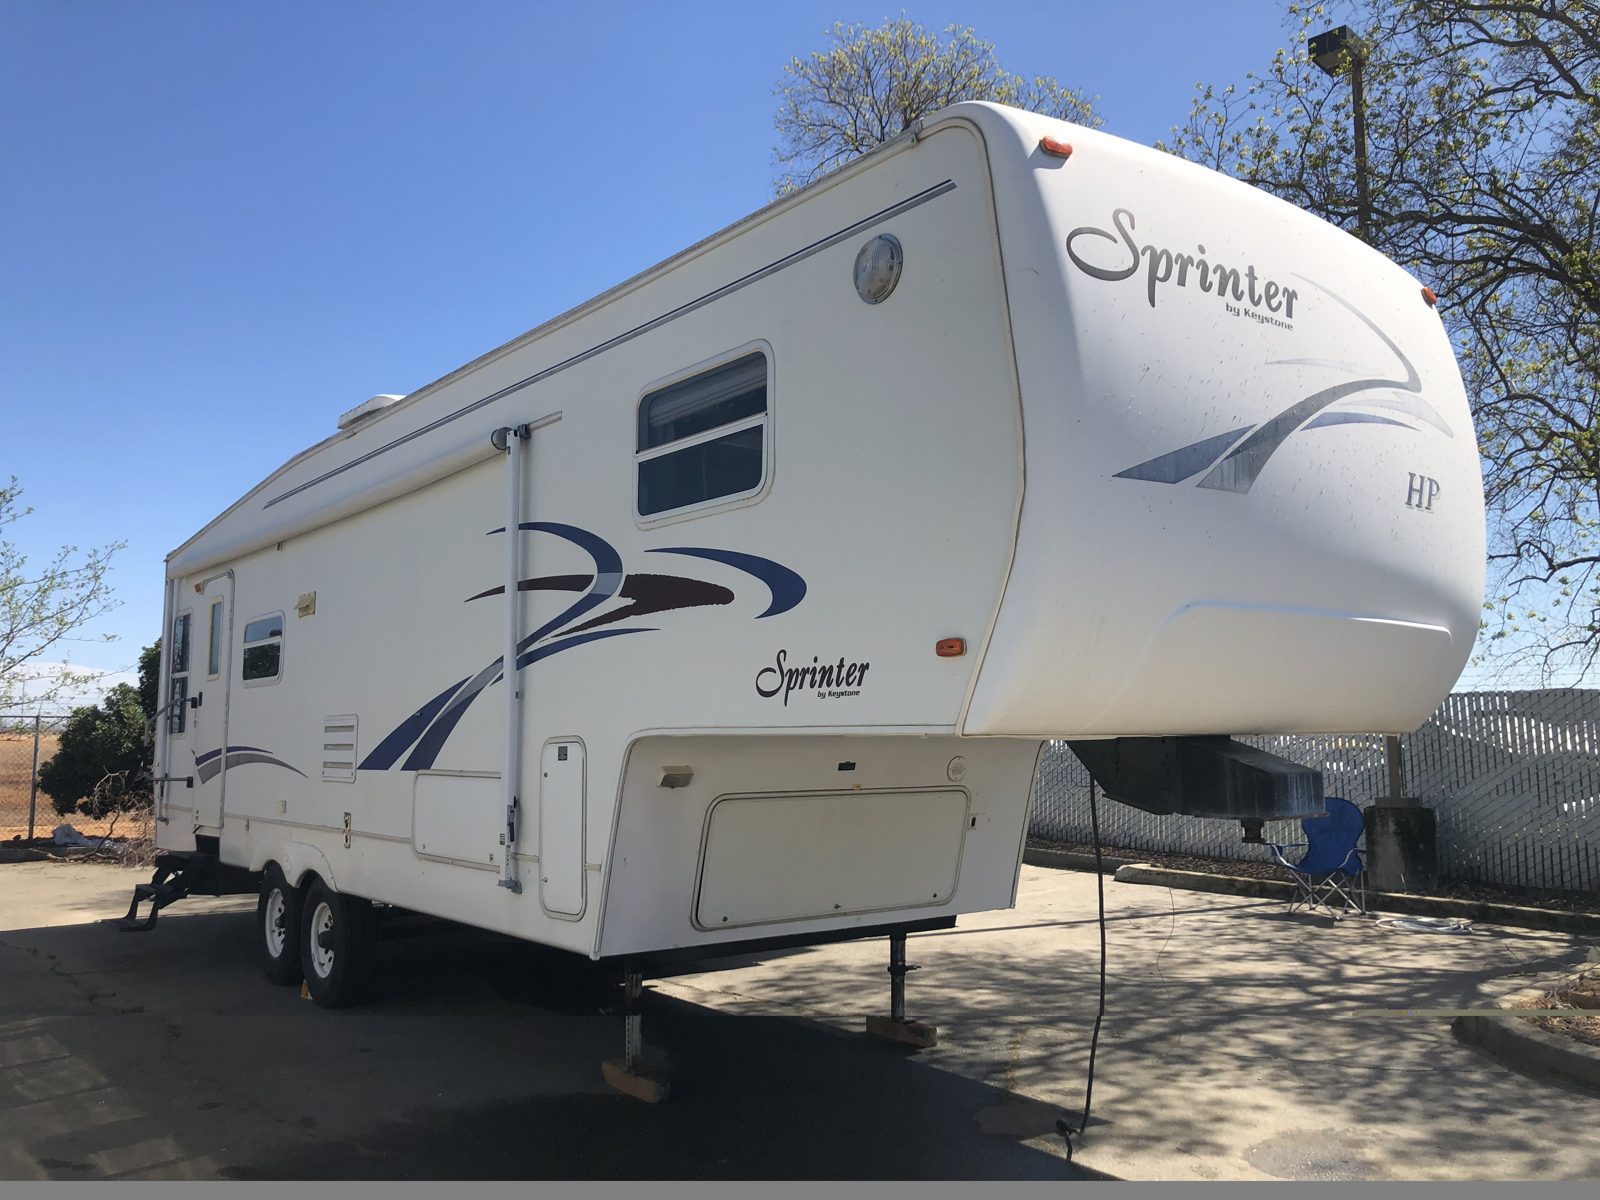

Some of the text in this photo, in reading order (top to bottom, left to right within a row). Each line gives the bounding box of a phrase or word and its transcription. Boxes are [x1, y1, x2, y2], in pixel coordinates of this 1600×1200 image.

[1066, 207, 1298, 318] Sprinter
[1226, 302, 1293, 331] by Keystone
[1405, 472, 1440, 510] HP
[756, 649, 869, 707] Sprinter
[817, 690, 861, 699] by Keystone
